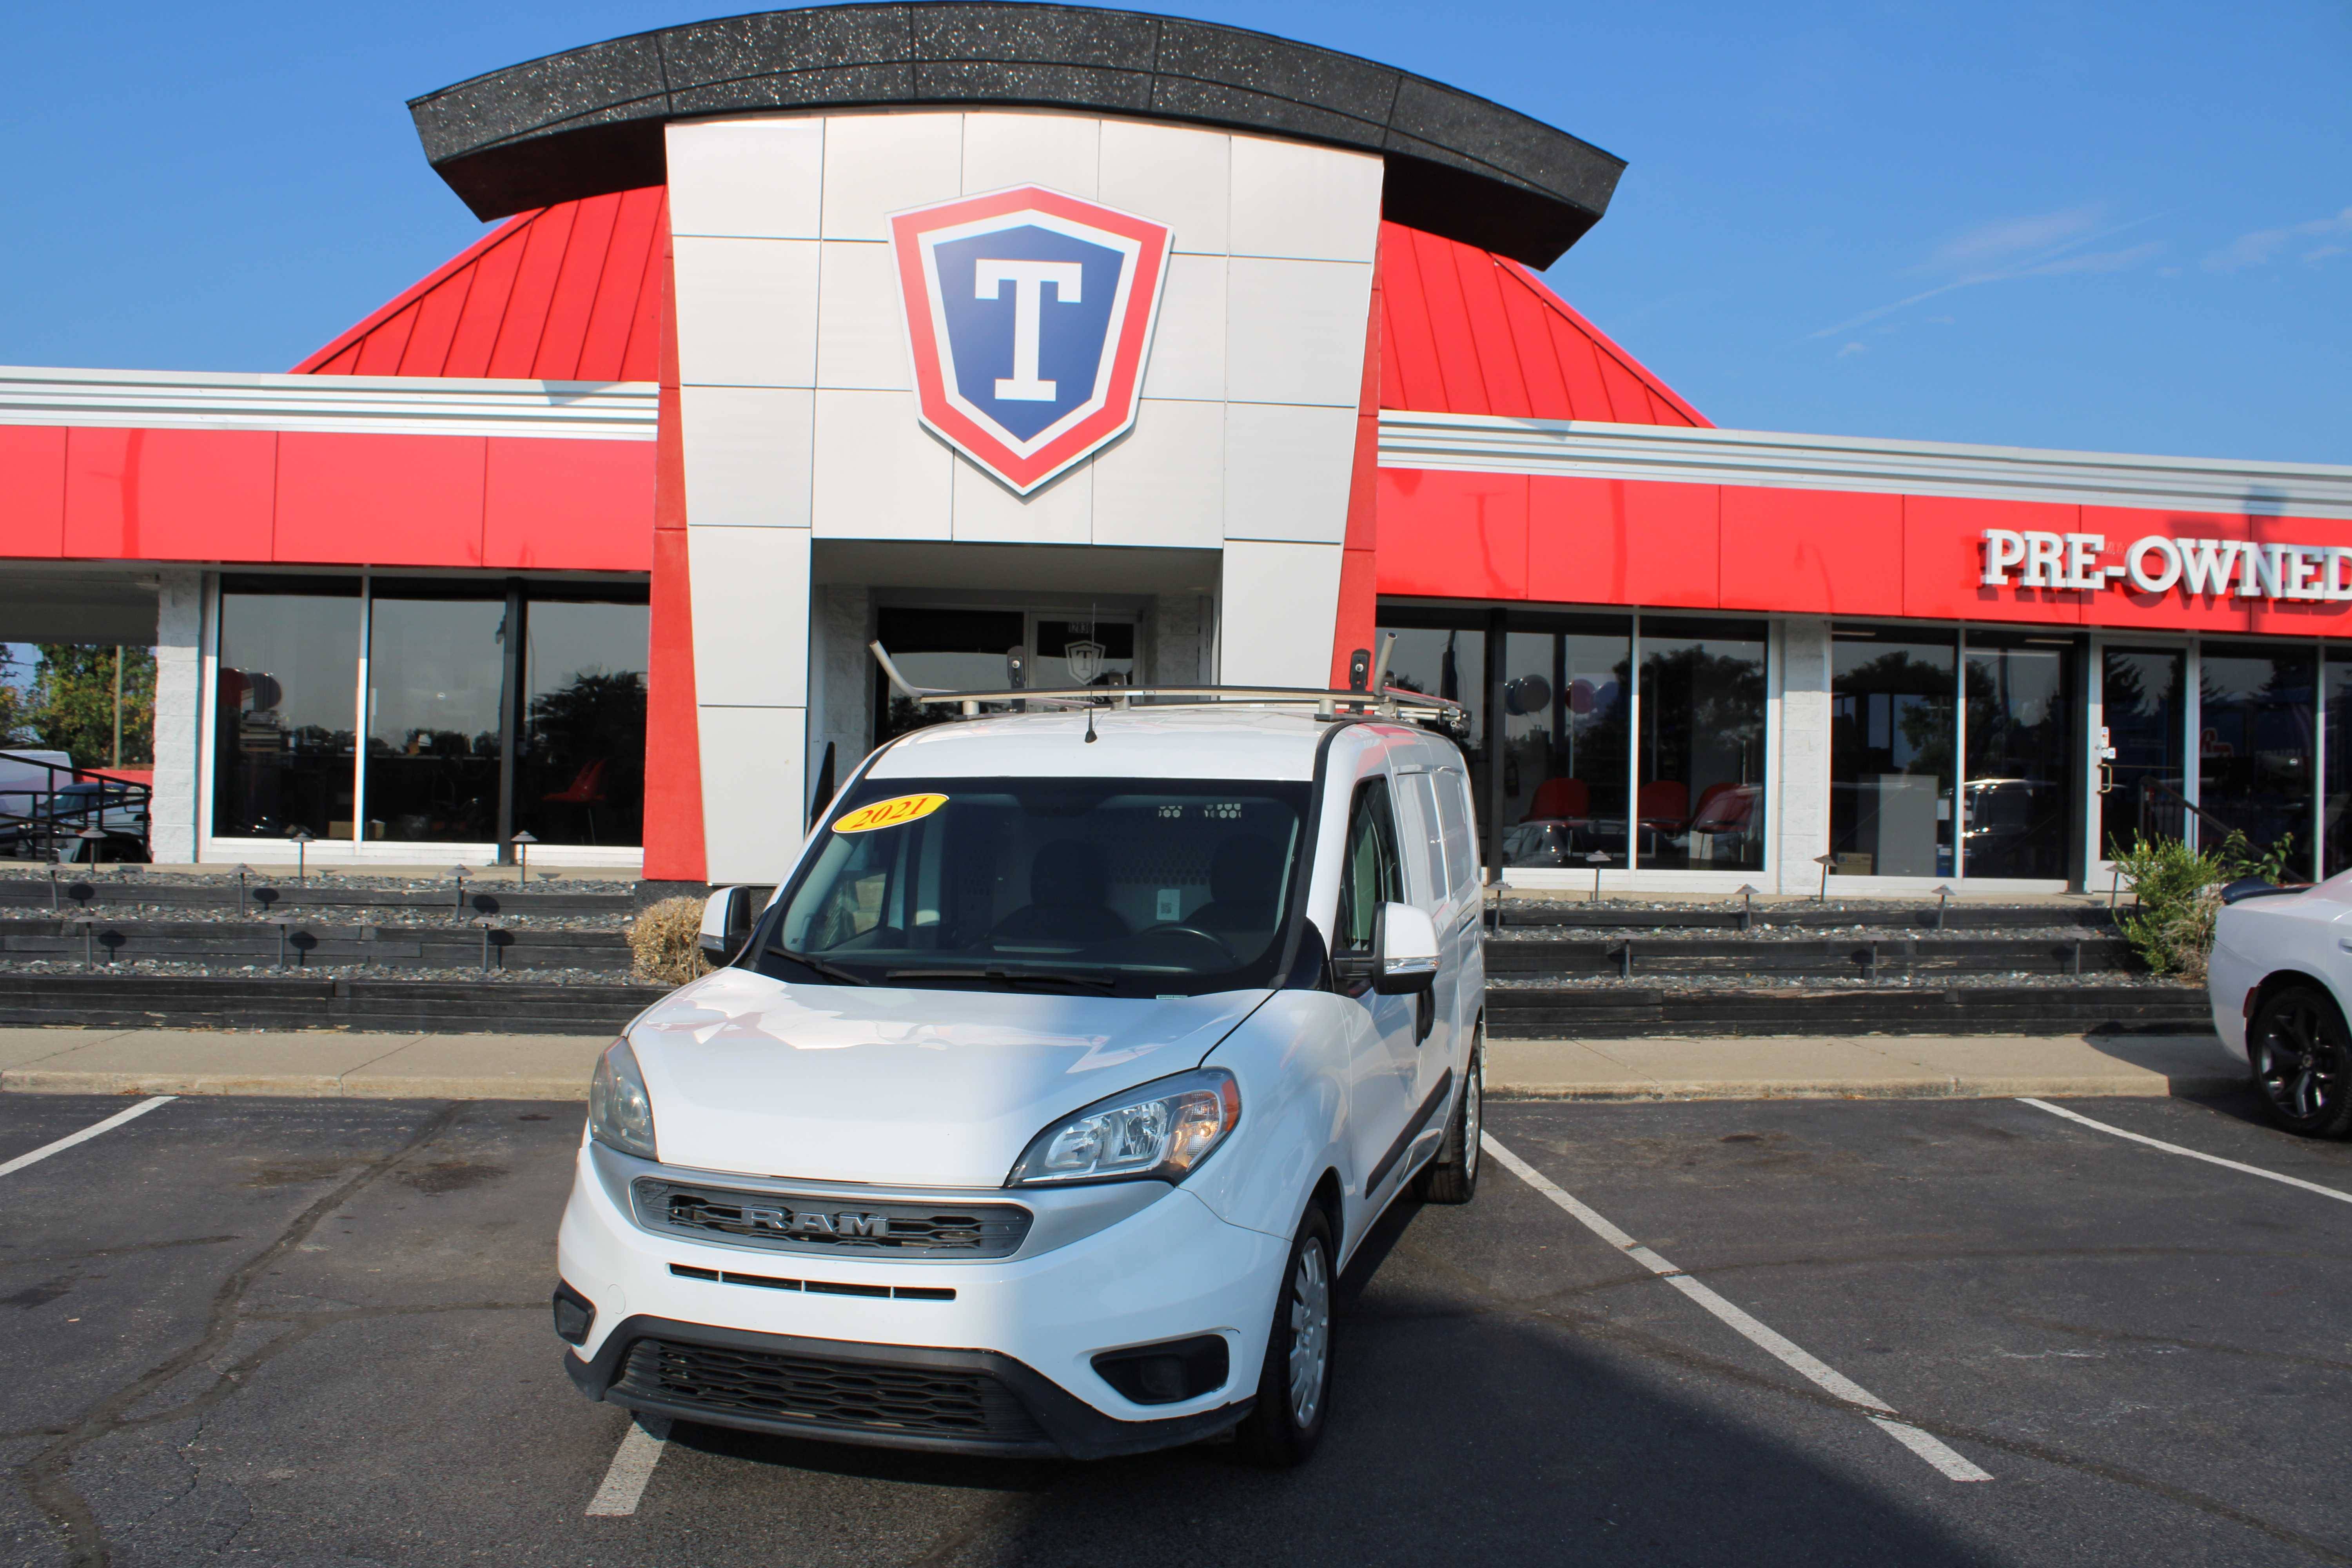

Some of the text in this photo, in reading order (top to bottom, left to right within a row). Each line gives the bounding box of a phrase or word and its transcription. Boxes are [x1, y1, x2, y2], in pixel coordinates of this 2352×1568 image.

[975, 258, 1082, 402] T
[1982, 528, 2352, 600] PRE-OWNED
[1076, 650, 1093, 671] T
[849, 797, 929, 829] 2021
[741, 1207, 888, 1237] RAM
